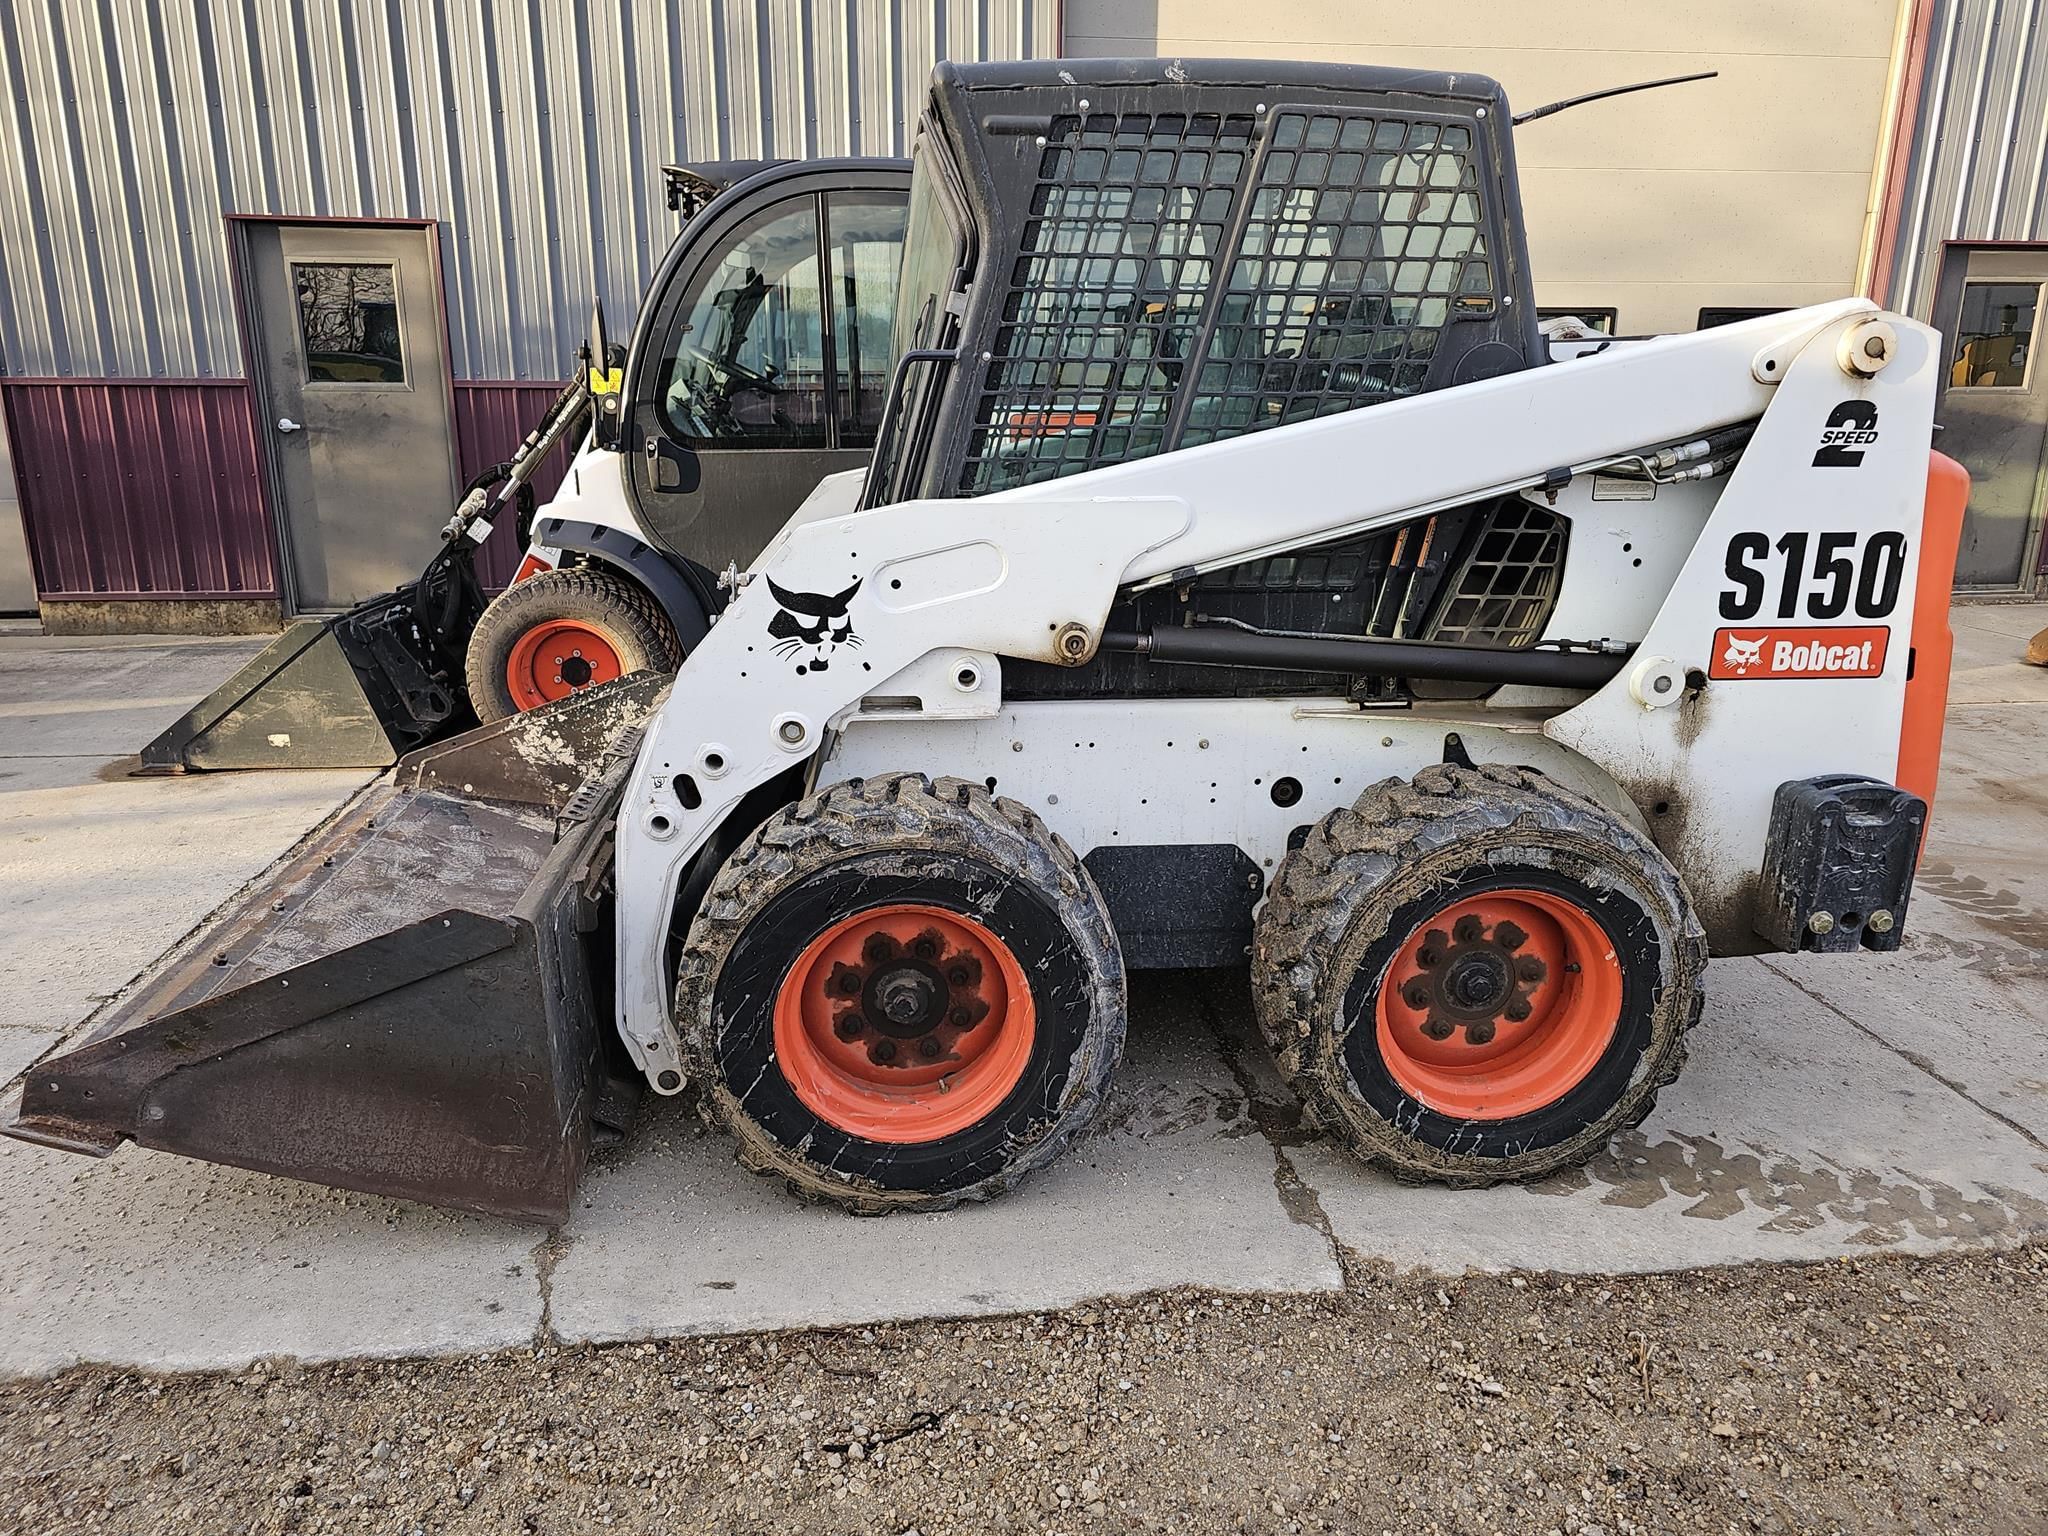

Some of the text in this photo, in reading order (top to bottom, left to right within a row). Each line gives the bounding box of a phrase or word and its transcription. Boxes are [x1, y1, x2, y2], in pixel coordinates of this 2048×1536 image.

[1811, 400, 1879, 467] 2
[1820, 430, 1879, 444] SPEED
[1718, 531, 1907, 620] S150
[1771, 640, 1873, 672] Bobcat
